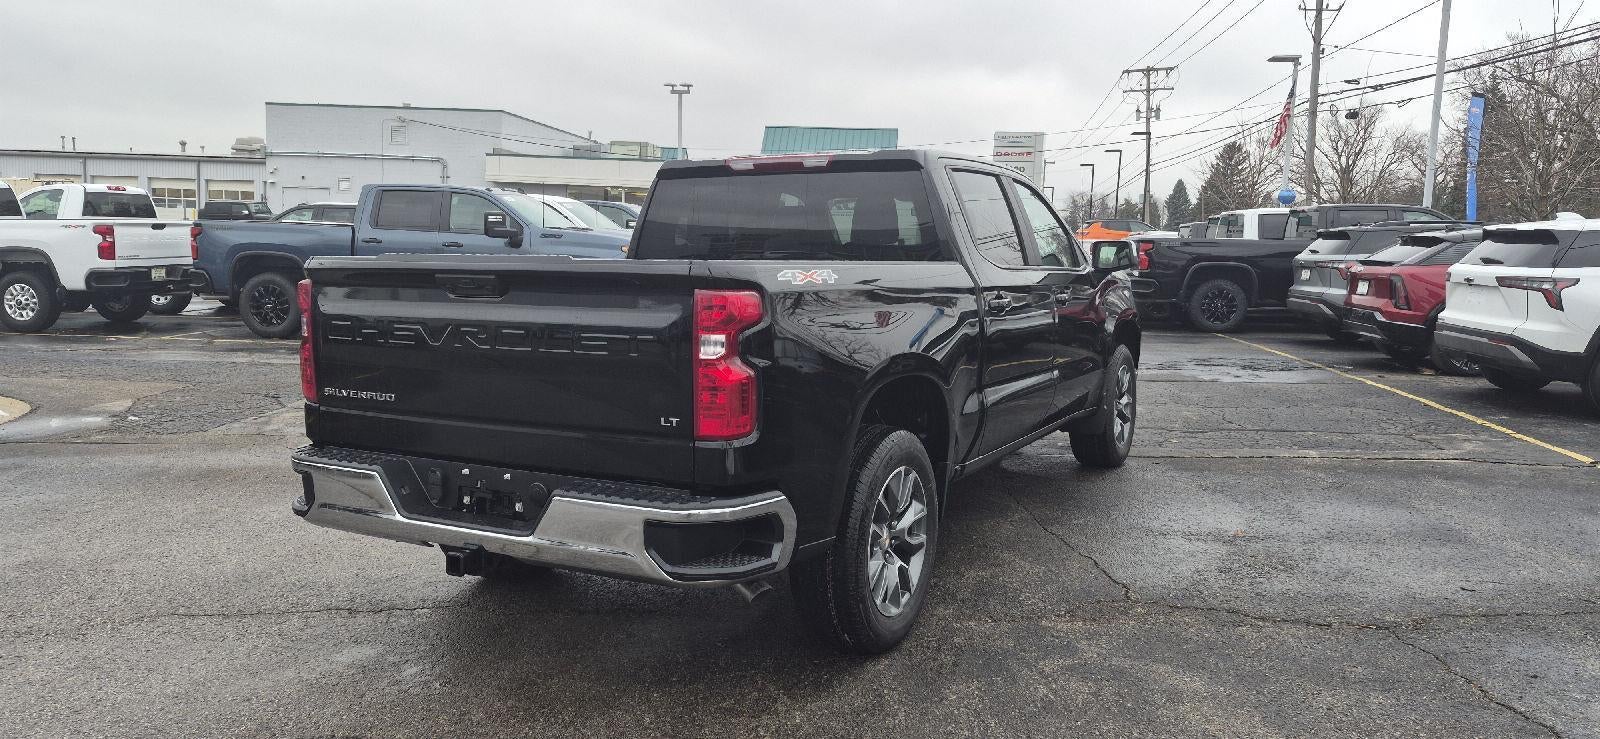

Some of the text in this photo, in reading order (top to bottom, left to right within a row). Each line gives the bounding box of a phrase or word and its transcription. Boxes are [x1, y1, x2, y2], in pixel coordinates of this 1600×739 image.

[328, 320, 655, 357] CHEVROLET
[323, 387, 396, 401] SILVERADO
[660, 417, 681, 427] LT
